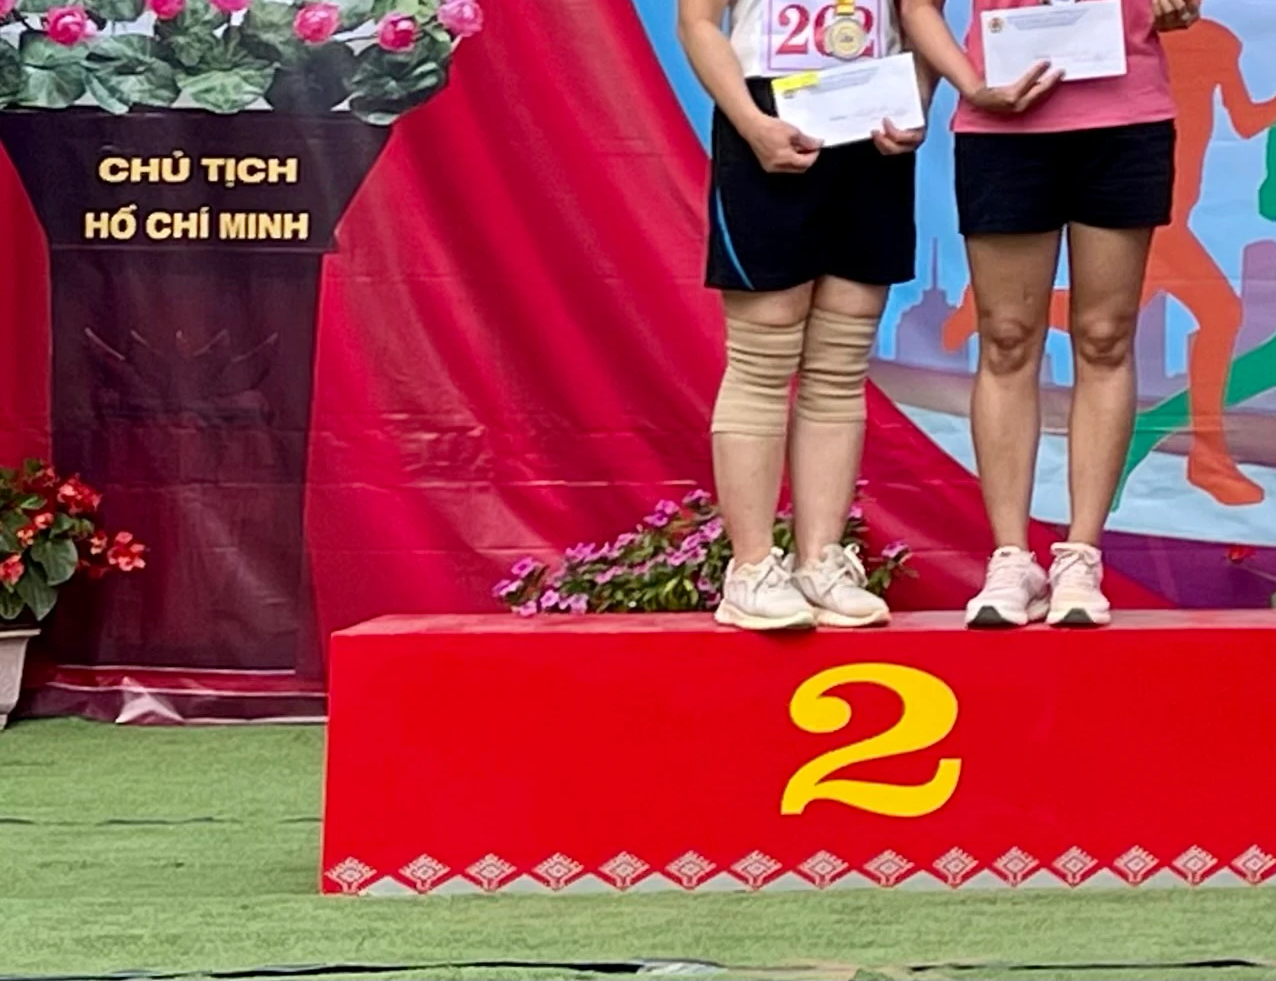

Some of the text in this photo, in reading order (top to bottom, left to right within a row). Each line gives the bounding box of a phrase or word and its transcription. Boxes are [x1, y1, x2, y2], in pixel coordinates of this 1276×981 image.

[98, 150, 298, 188] CHỦ TỊCH
[146, 206, 209, 239] CHÍ
[219, 212, 308, 240] MINH
[780, 663, 961, 817] 2
